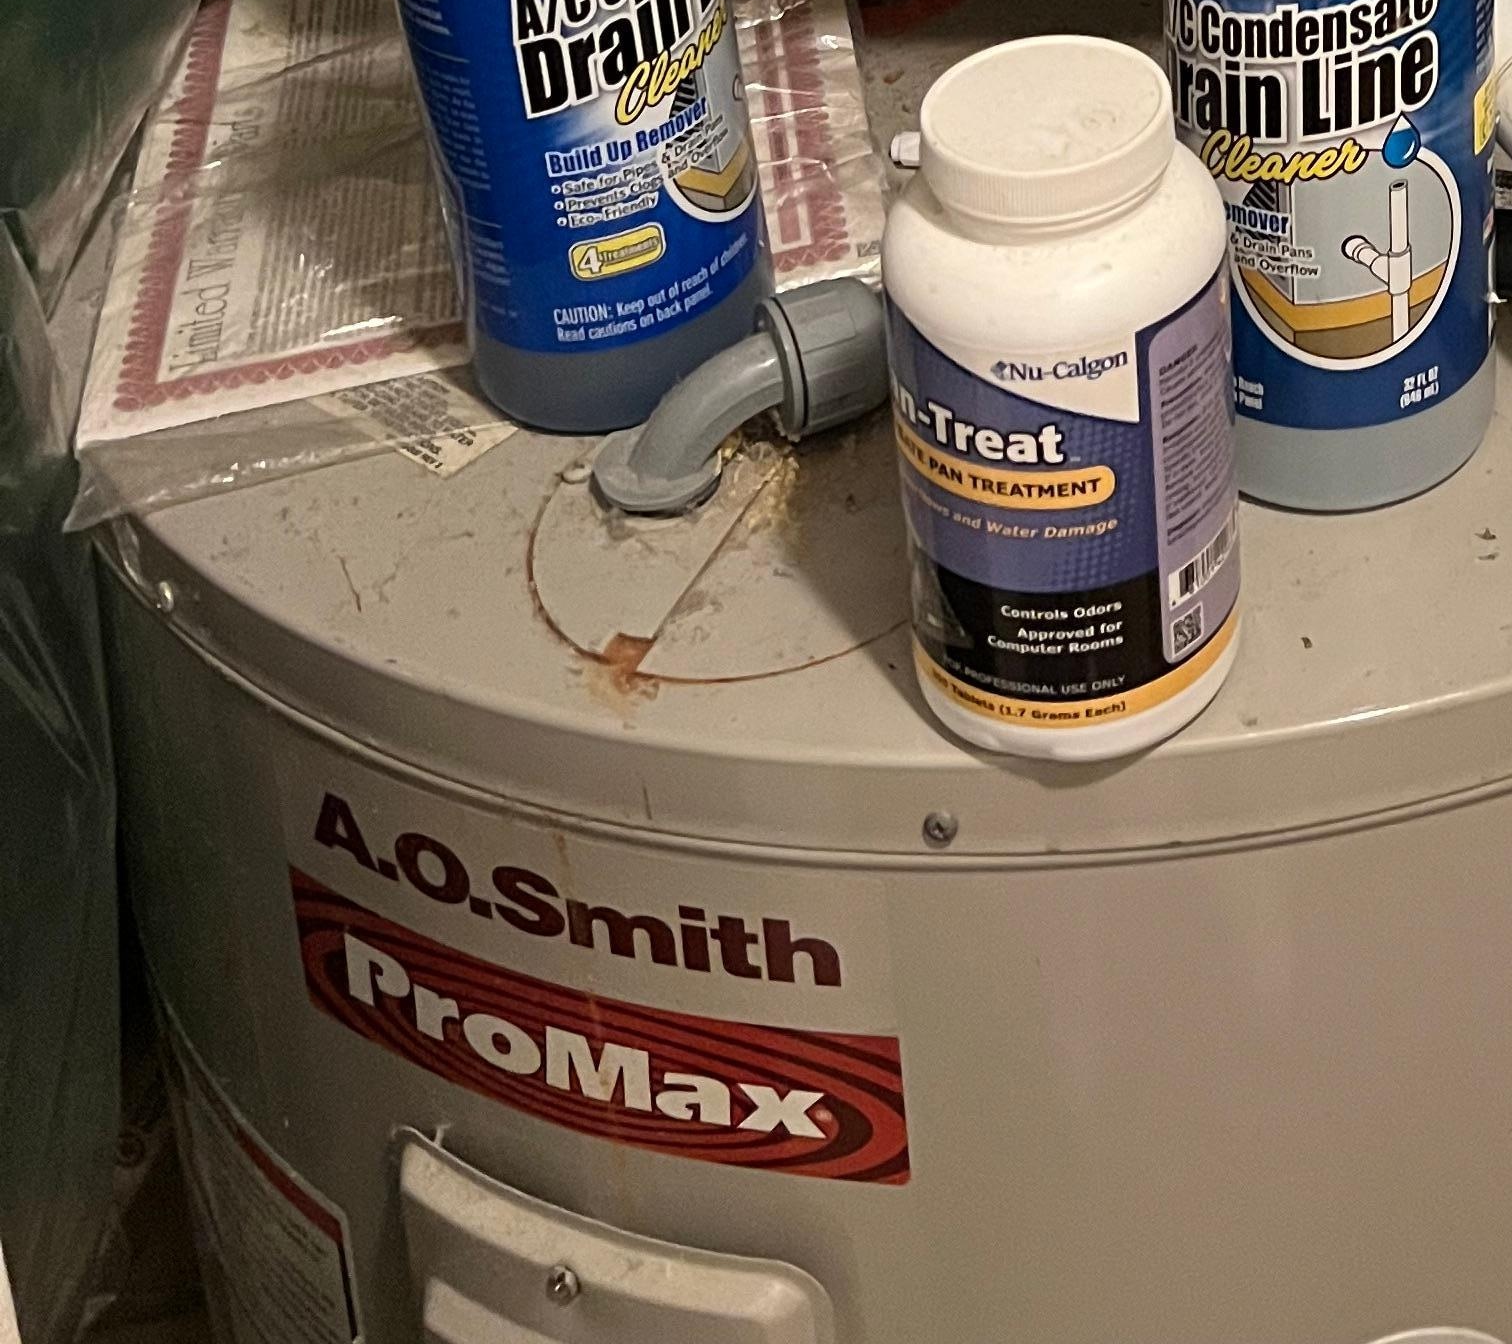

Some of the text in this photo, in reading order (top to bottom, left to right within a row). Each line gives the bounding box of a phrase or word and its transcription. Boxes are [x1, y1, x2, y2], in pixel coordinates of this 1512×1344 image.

[1168, 36, 1434, 140] rain Line
[550, 97, 707, 174] Build Up Remover
[1201, 129, 1369, 183] Cleaner
[563, 182, 595, 195] Safe
[598, 174, 619, 188] for
[623, 161, 659, 180] Pipes
[567, 189, 626, 212] Prevents
[630, 176, 664, 194] Clogs
[604, 195, 658, 219] Friendly
[1224, 200, 1289, 234] mover
[578, 246, 602, 275] 4
[1244, 237, 1277, 254] Drain
[1281, 244, 1313, 258] Pans
[1235, 254, 1319, 276] and Overflow
[553, 304, 613, 325] CAUTION:
[616, 299, 645, 317] Keep
[647, 288, 666, 308] out
[668, 280, 679, 300] of
[682, 268, 708, 293] reach
[557, 326, 586, 342] Read
[588, 318, 637, 340] cautions
[639, 313, 655, 328] on
[656, 299, 682, 323] back
[1008, 349, 1129, 382] Nu-Calgon
[896, 382, 1065, 464] n-Treat
[929, 456, 964, 486] PAN
[967, 474, 1103, 499] TREATMENT
[953, 512, 1120, 540] and Water Damage
[1000, 600, 1123, 621] Controls Odors
[987, 634, 1124, 656] Computer Rooms
[1017, 619, 1123, 643] Approved for
[964, 666, 1056, 695] PROFESSIONAL
[1061, 684, 1087, 696] USE
[1091, 675, 1126, 691] ONLY
[951, 683, 995, 712] Tablets
[999, 703, 1026, 718] (1.7
[1031, 709, 1080, 721] Grams
[1085, 700, 1127, 719] Each)
[313, 791, 842, 988] A.O.Smith
[343, 929, 827, 1141] ProMax
